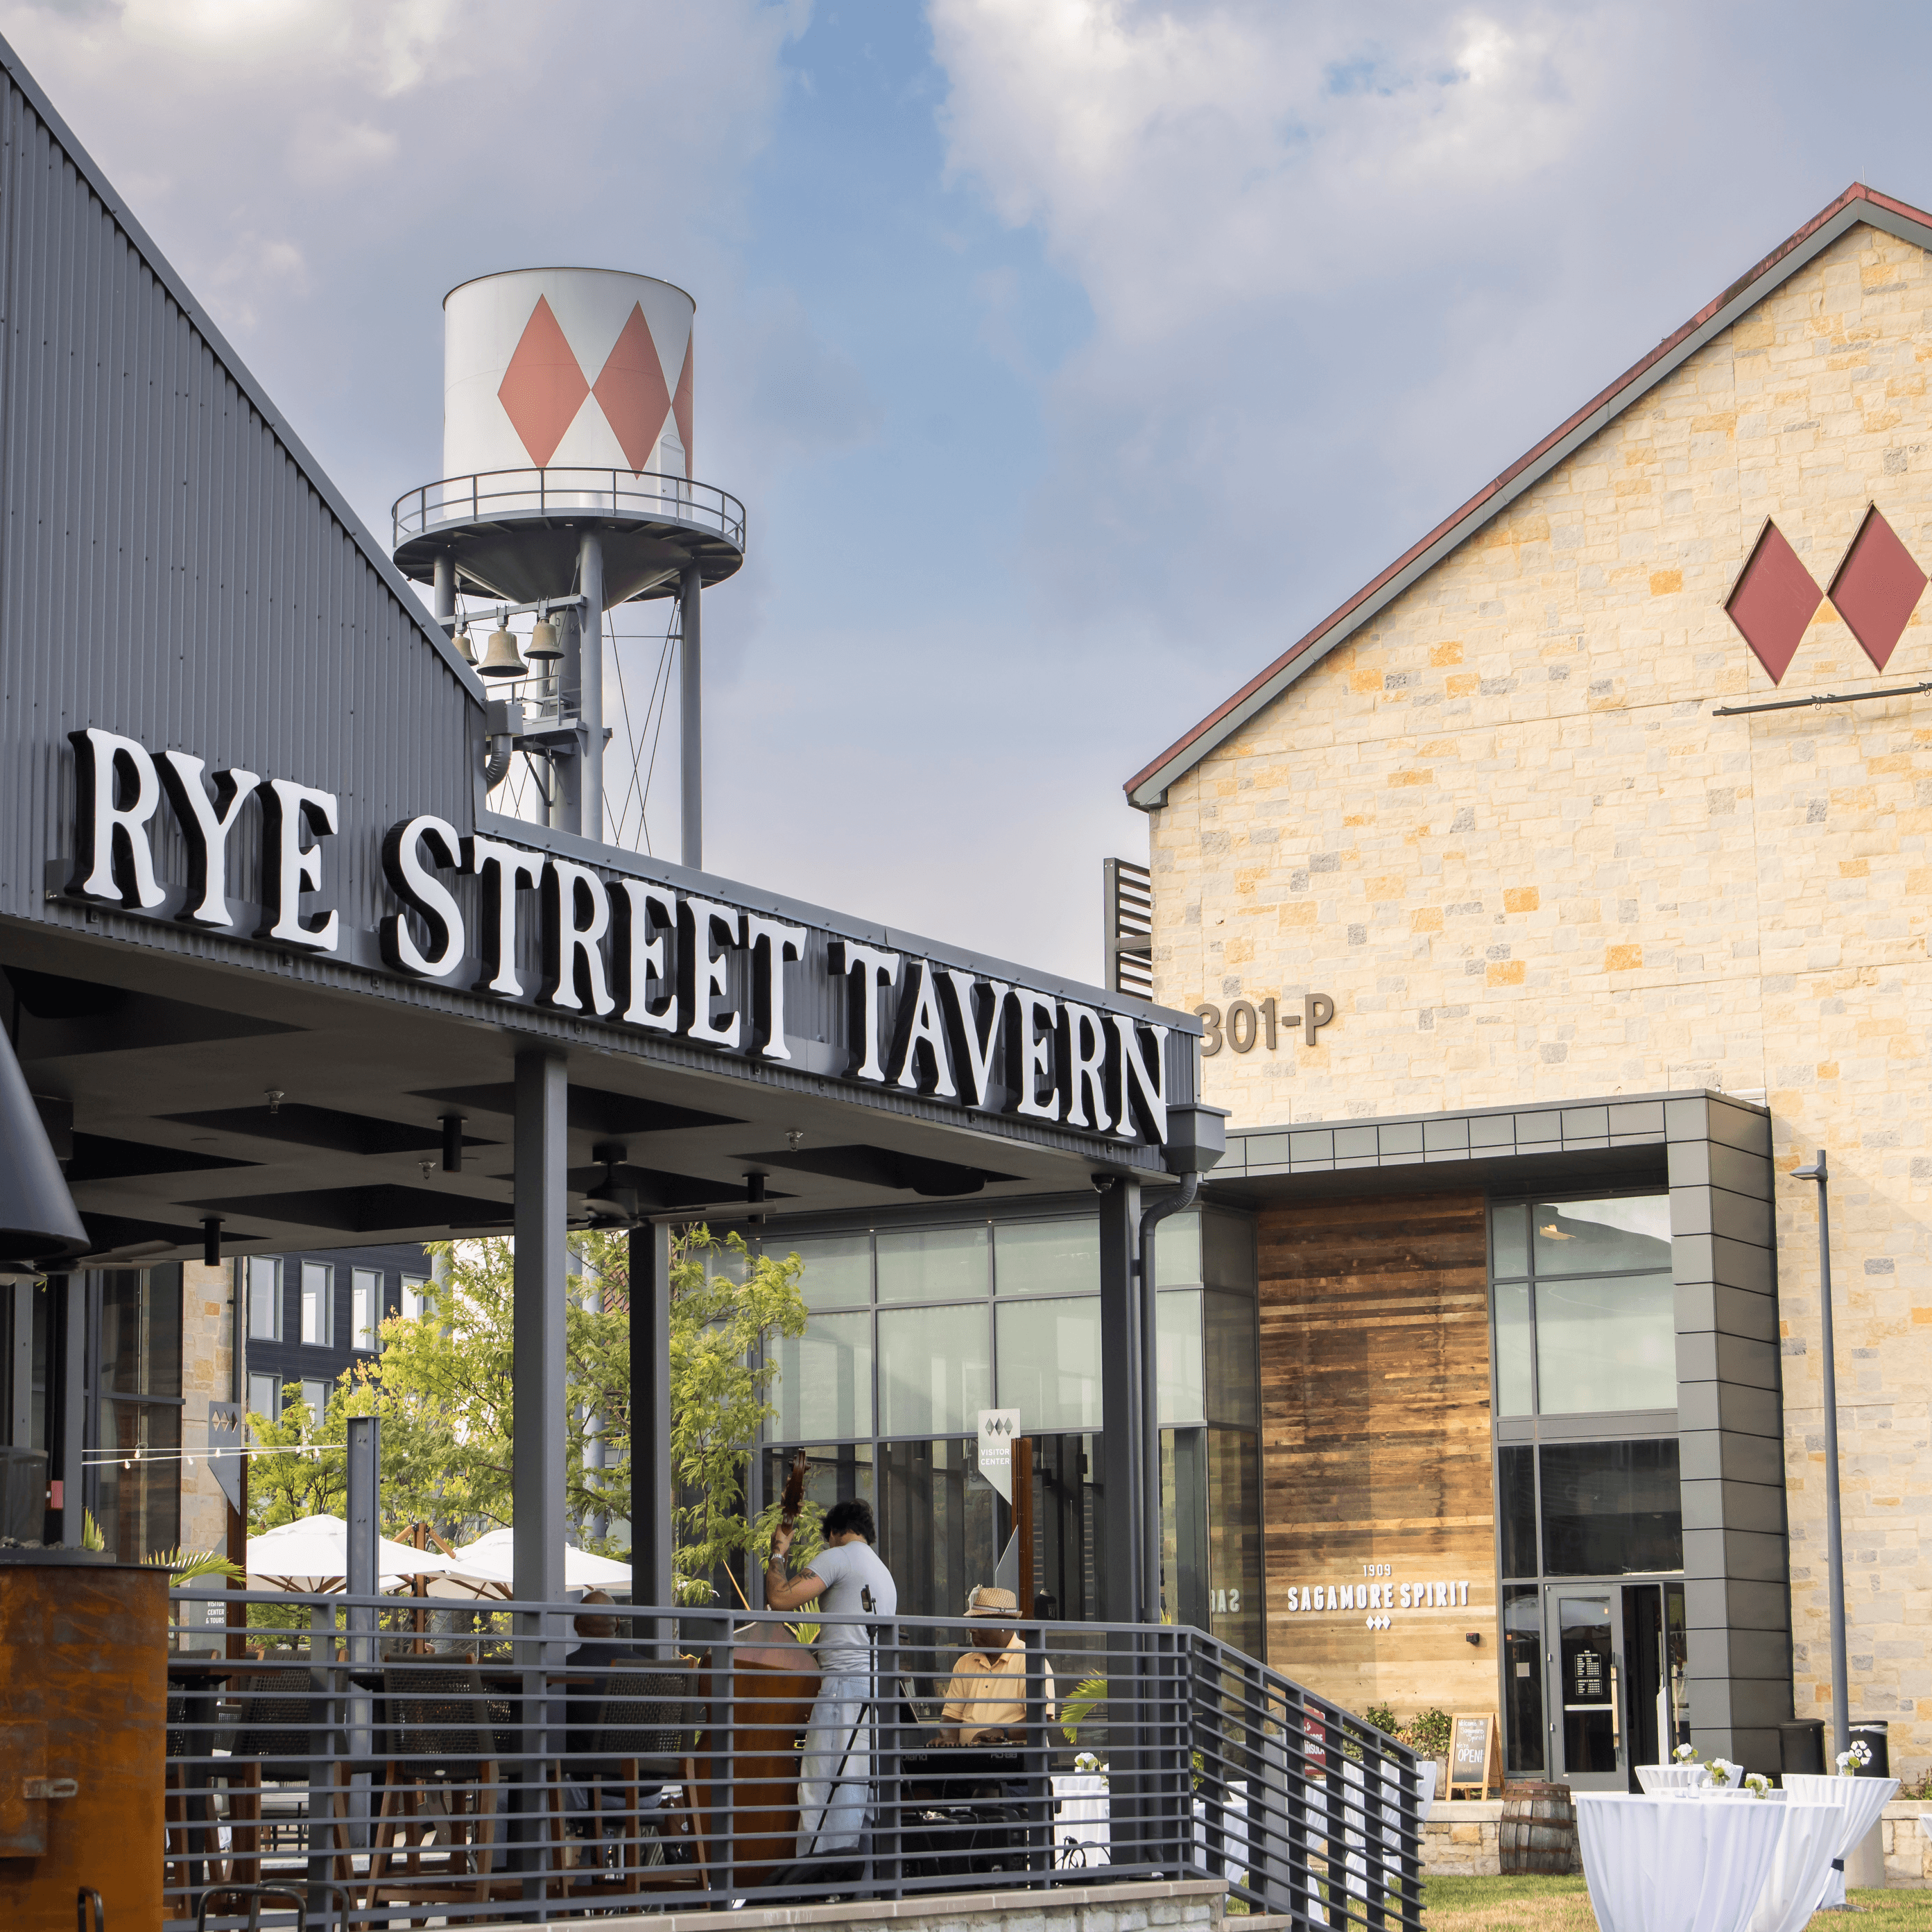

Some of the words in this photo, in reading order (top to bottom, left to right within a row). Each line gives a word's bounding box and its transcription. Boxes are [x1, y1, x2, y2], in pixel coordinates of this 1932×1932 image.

[82, 727, 338, 952] RYE
[394, 814, 807, 1061] STREET
[840, 938, 1169, 1146] TAVERN
[1193, 992, 1334, 1057] 301-P
[1363, 1564, 1392, 1577] 1909
[1288, 1583, 1394, 1612] SAGAMORE
[1400, 1581, 1469, 1608] SPIRIT
[1458, 1748, 1483, 1763] OPEN!
